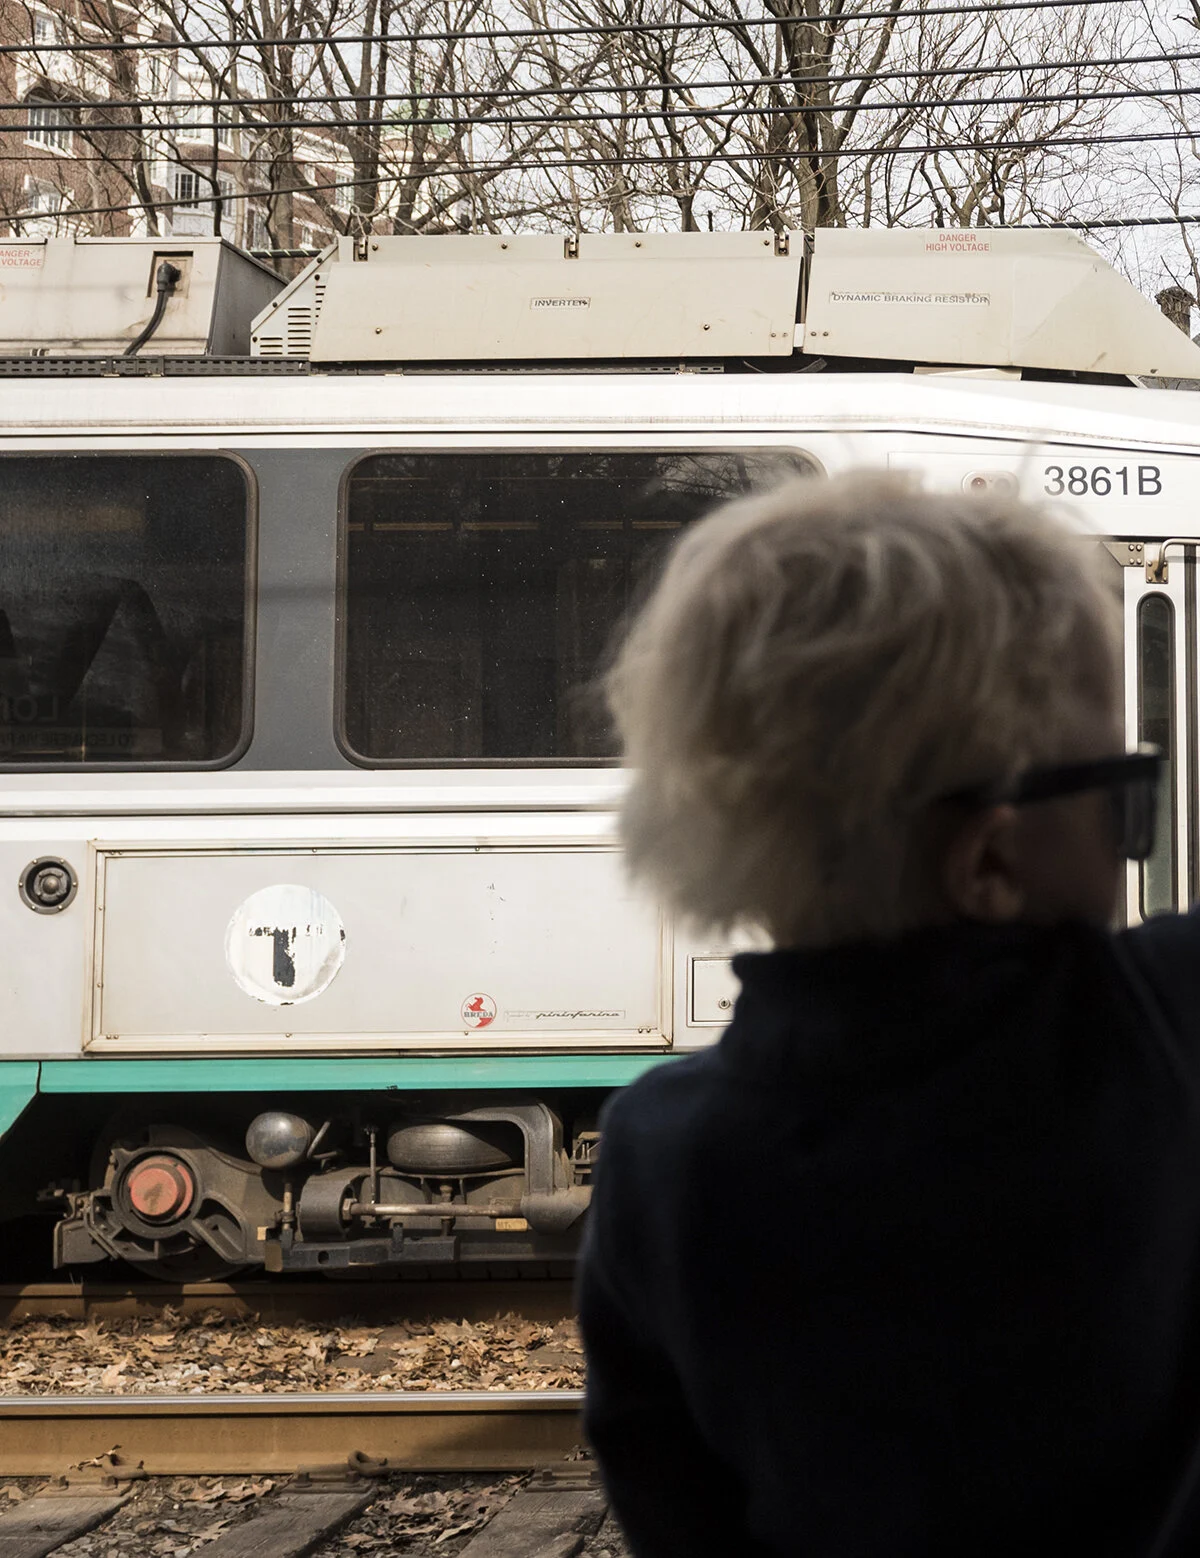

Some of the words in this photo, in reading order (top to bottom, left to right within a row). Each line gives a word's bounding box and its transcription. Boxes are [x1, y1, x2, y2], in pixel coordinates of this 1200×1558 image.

[939, 233, 977, 242] DANGER
[925, 243, 948, 251] HIGH
[949, 243, 990, 251] VOLTAGE
[832, 293, 881, 302] DYNAMIC
[884, 294, 932, 303] BRAKING
[934, 295, 987, 304] RESISTOR
[1044, 465, 1163, 496] 3861B
[535, 1010, 620, 1019] pininfarina
